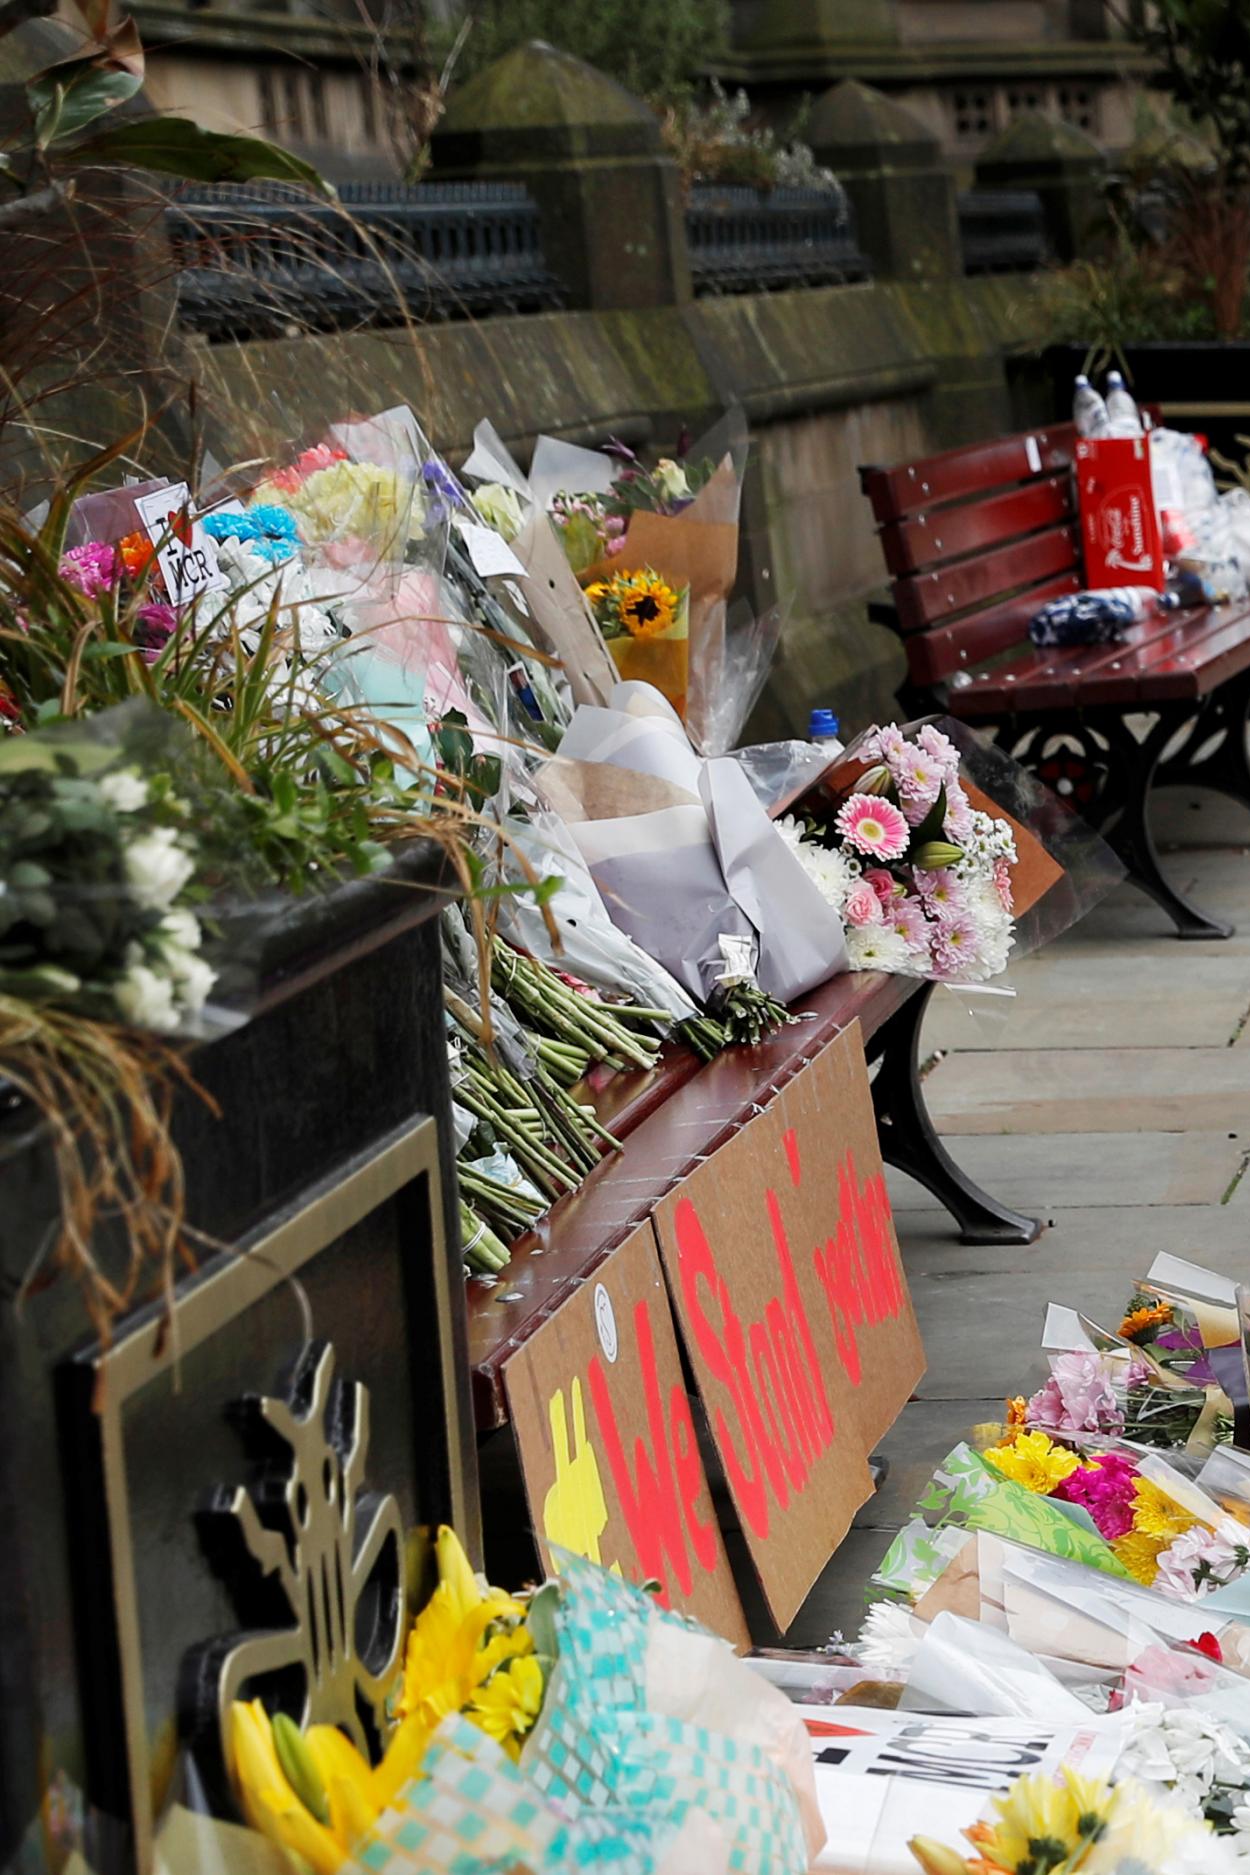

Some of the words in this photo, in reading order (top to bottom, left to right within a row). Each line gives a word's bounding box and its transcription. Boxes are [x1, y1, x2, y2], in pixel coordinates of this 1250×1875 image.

[156, 517, 177, 556] I
[168, 550, 213, 588] MCR
[588, 1300, 716, 1610] We
[673, 1188, 834, 1541] Stand
